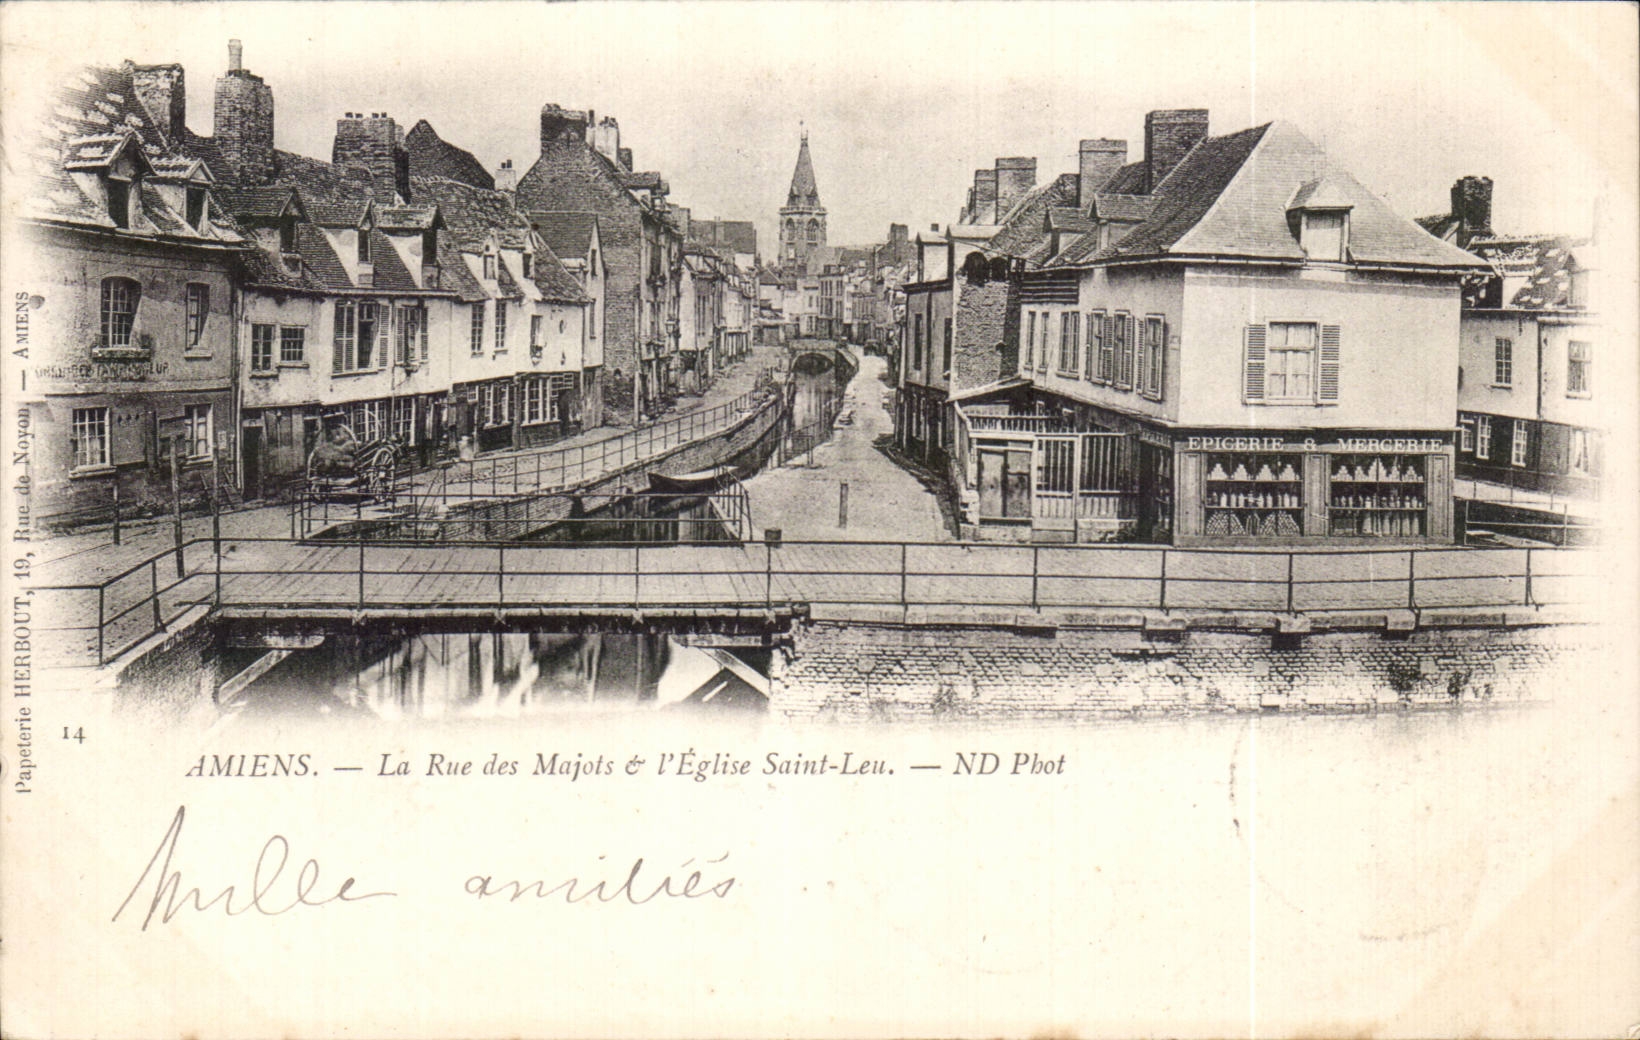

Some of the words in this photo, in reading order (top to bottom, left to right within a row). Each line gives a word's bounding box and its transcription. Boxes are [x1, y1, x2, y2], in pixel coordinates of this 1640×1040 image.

[1188, 437, 1284, 450] EPICERIE
[1304, 438, 1316, 449] &
[1337, 438, 1443, 452] MERCERIE
